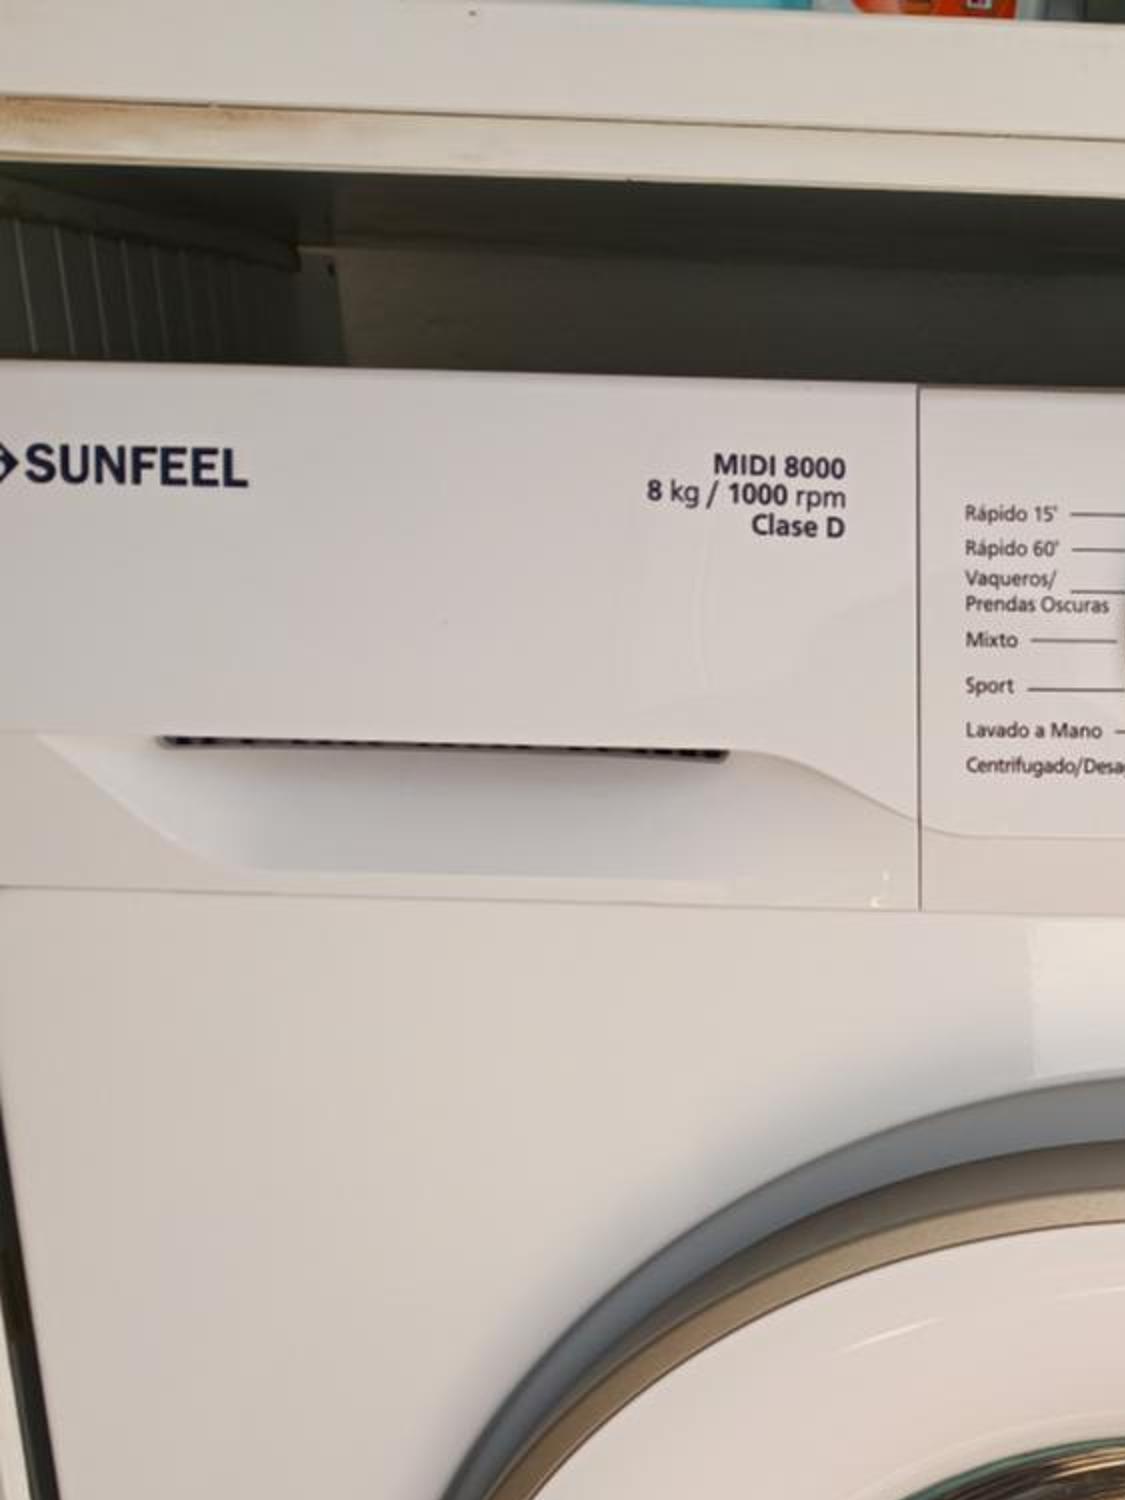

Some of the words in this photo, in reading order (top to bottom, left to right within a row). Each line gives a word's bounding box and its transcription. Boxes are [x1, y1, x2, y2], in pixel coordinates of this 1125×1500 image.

[25, 443, 249, 488] SUNFEEL
[714, 453, 776, 476] MIDI
[784, 455, 846, 479] 8000
[647, 479, 663, 501] 8
[671, 479, 700, 509] kg
[729, 483, 788, 506] 1000
[796, 490, 846, 513] rpm
[752, 513, 818, 537] Clase
[827, 516, 845, 538] D
[965, 504, 1027, 526] Rápido
[965, 540, 1028, 560] Rápido
[965, 570, 1057, 592] Vaqueros/
[965, 596, 1036, 613] Prendas
[1041, 597, 1109, 614] Oscuras
[965, 632, 1018, 648] Mixto
[965, 677, 1015, 698] Sport
[965, 722, 1029, 739] Lavado
[1035, 727, 1045, 739] a
[1051, 722, 1103, 740] Mano
